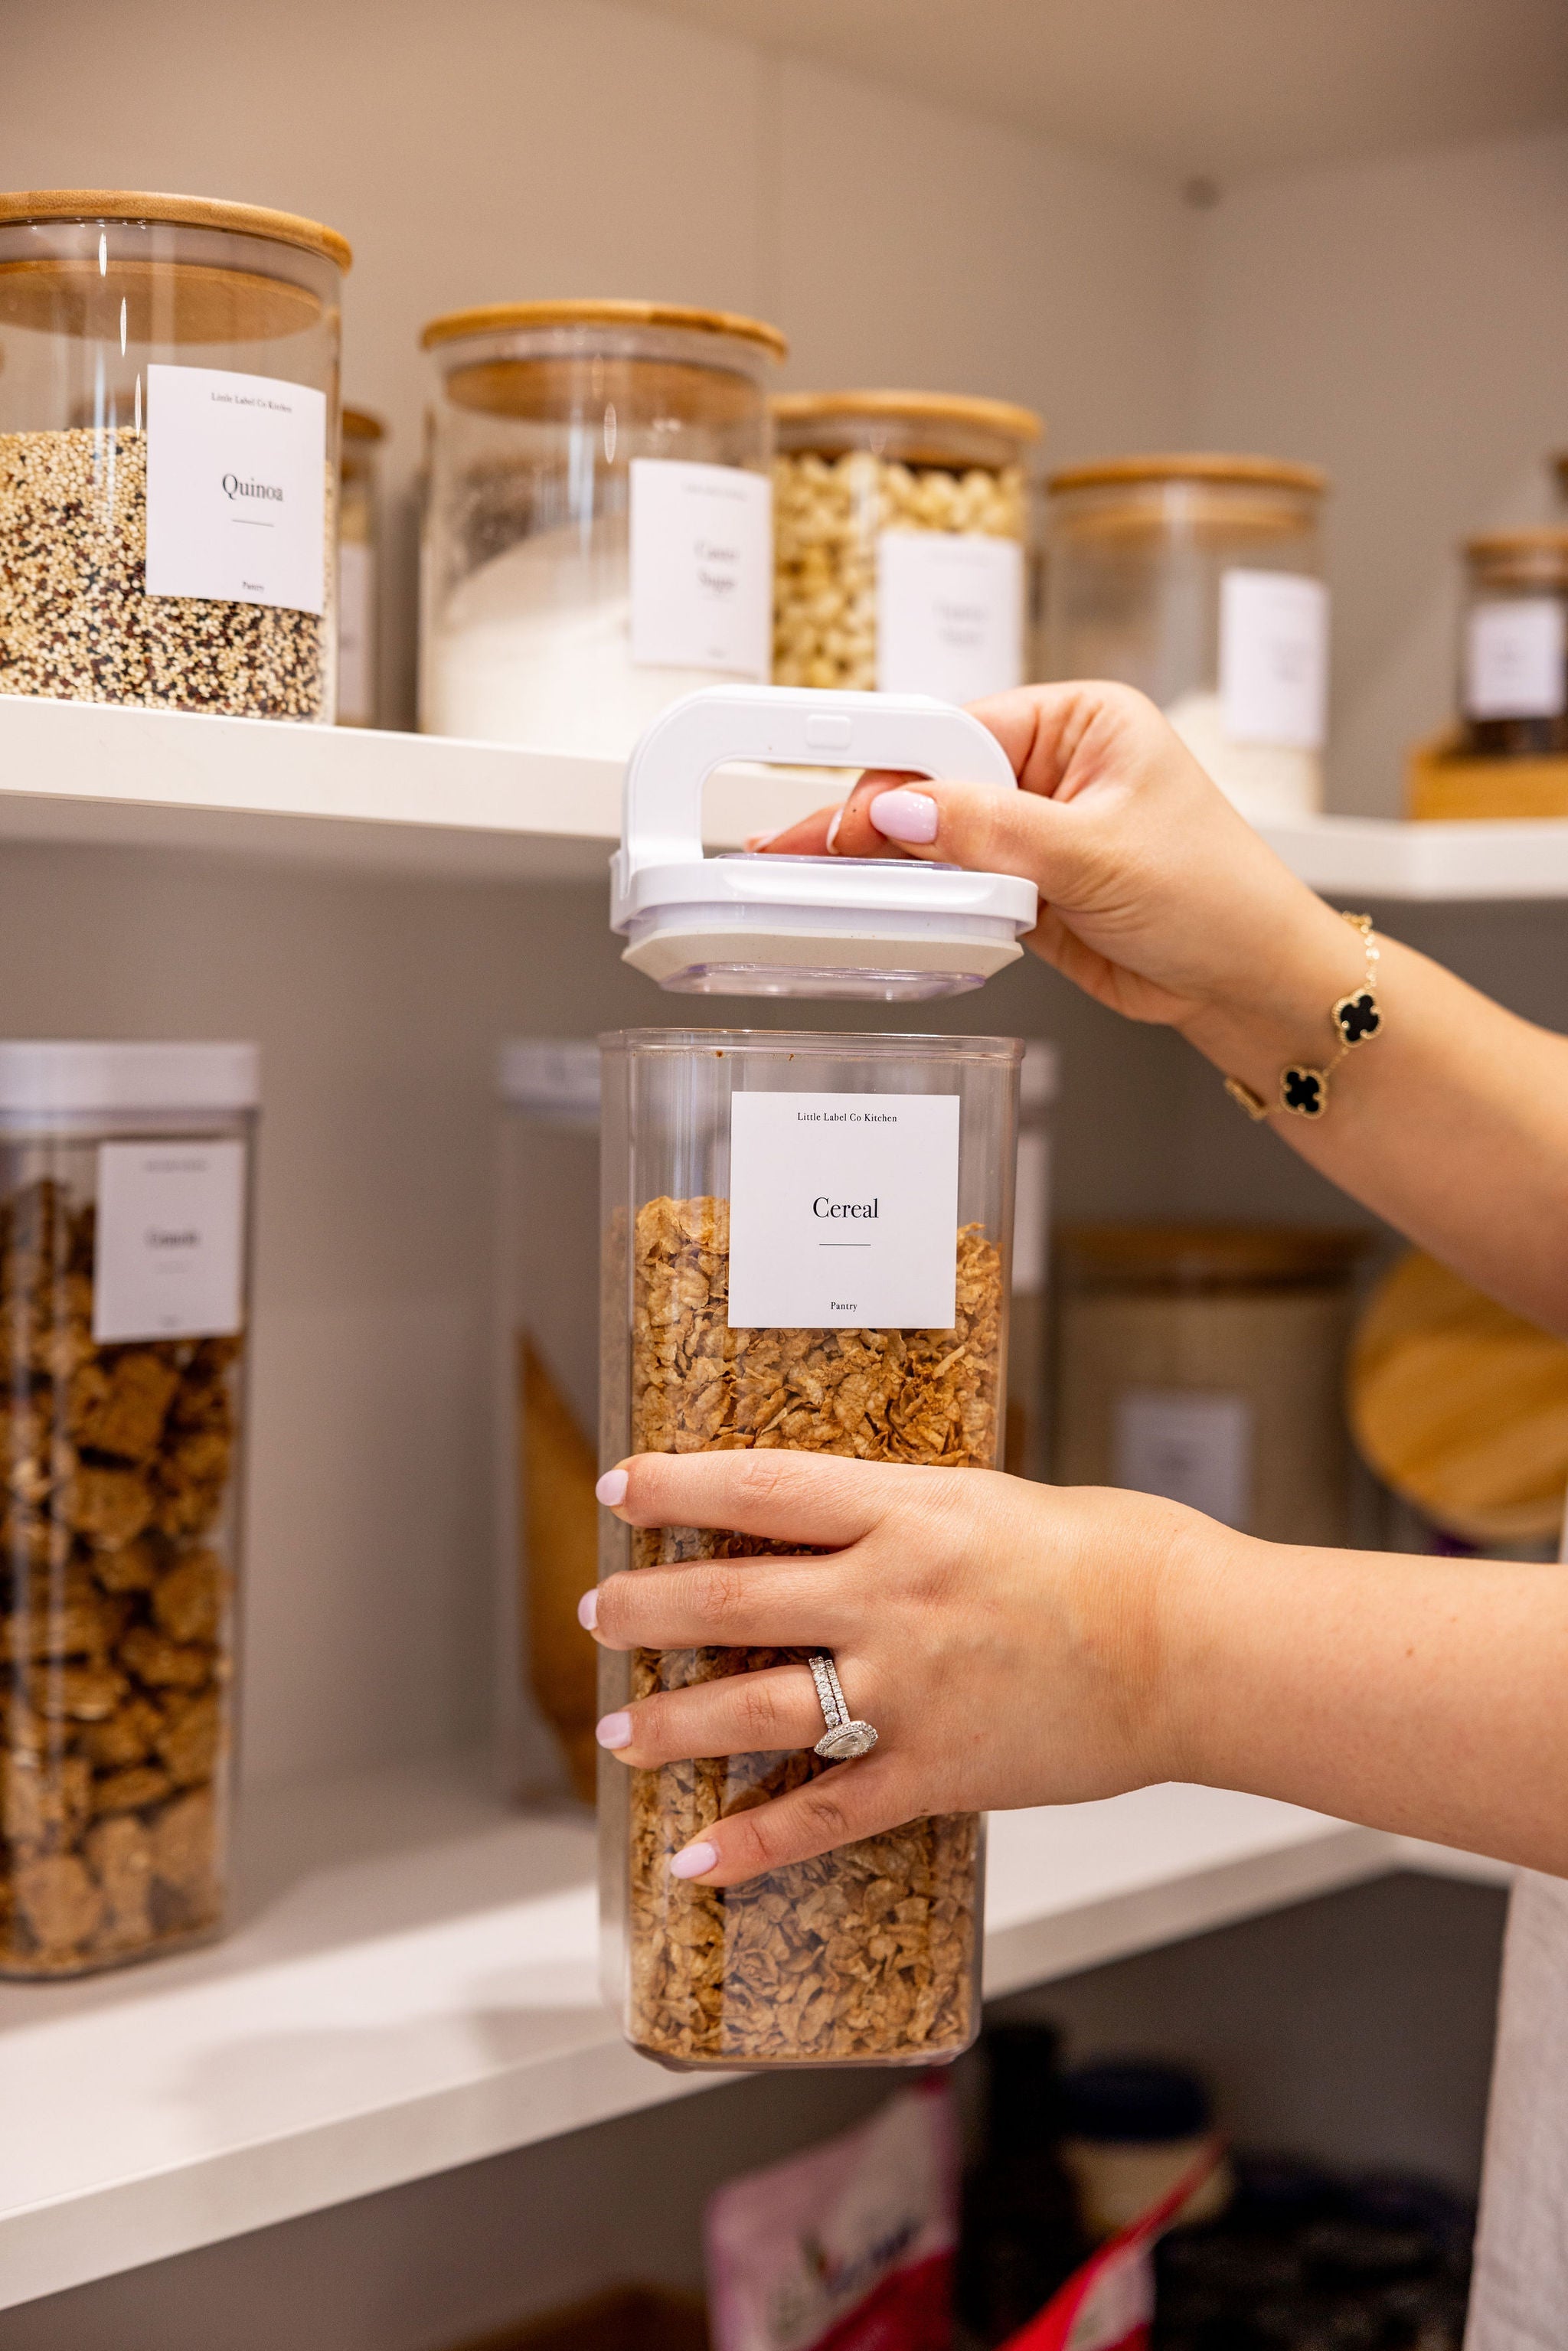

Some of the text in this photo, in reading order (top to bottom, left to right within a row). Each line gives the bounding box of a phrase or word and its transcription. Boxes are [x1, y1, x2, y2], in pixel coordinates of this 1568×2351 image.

[222, 473, 284, 501] Quinoa
[242, 581, 264, 593] Pantry
[797, 1112, 897, 1123] Little Label Co Kitchen
[812, 1197, 879, 1219] Cereal
[831, 1301, 858, 1312] Pantry
